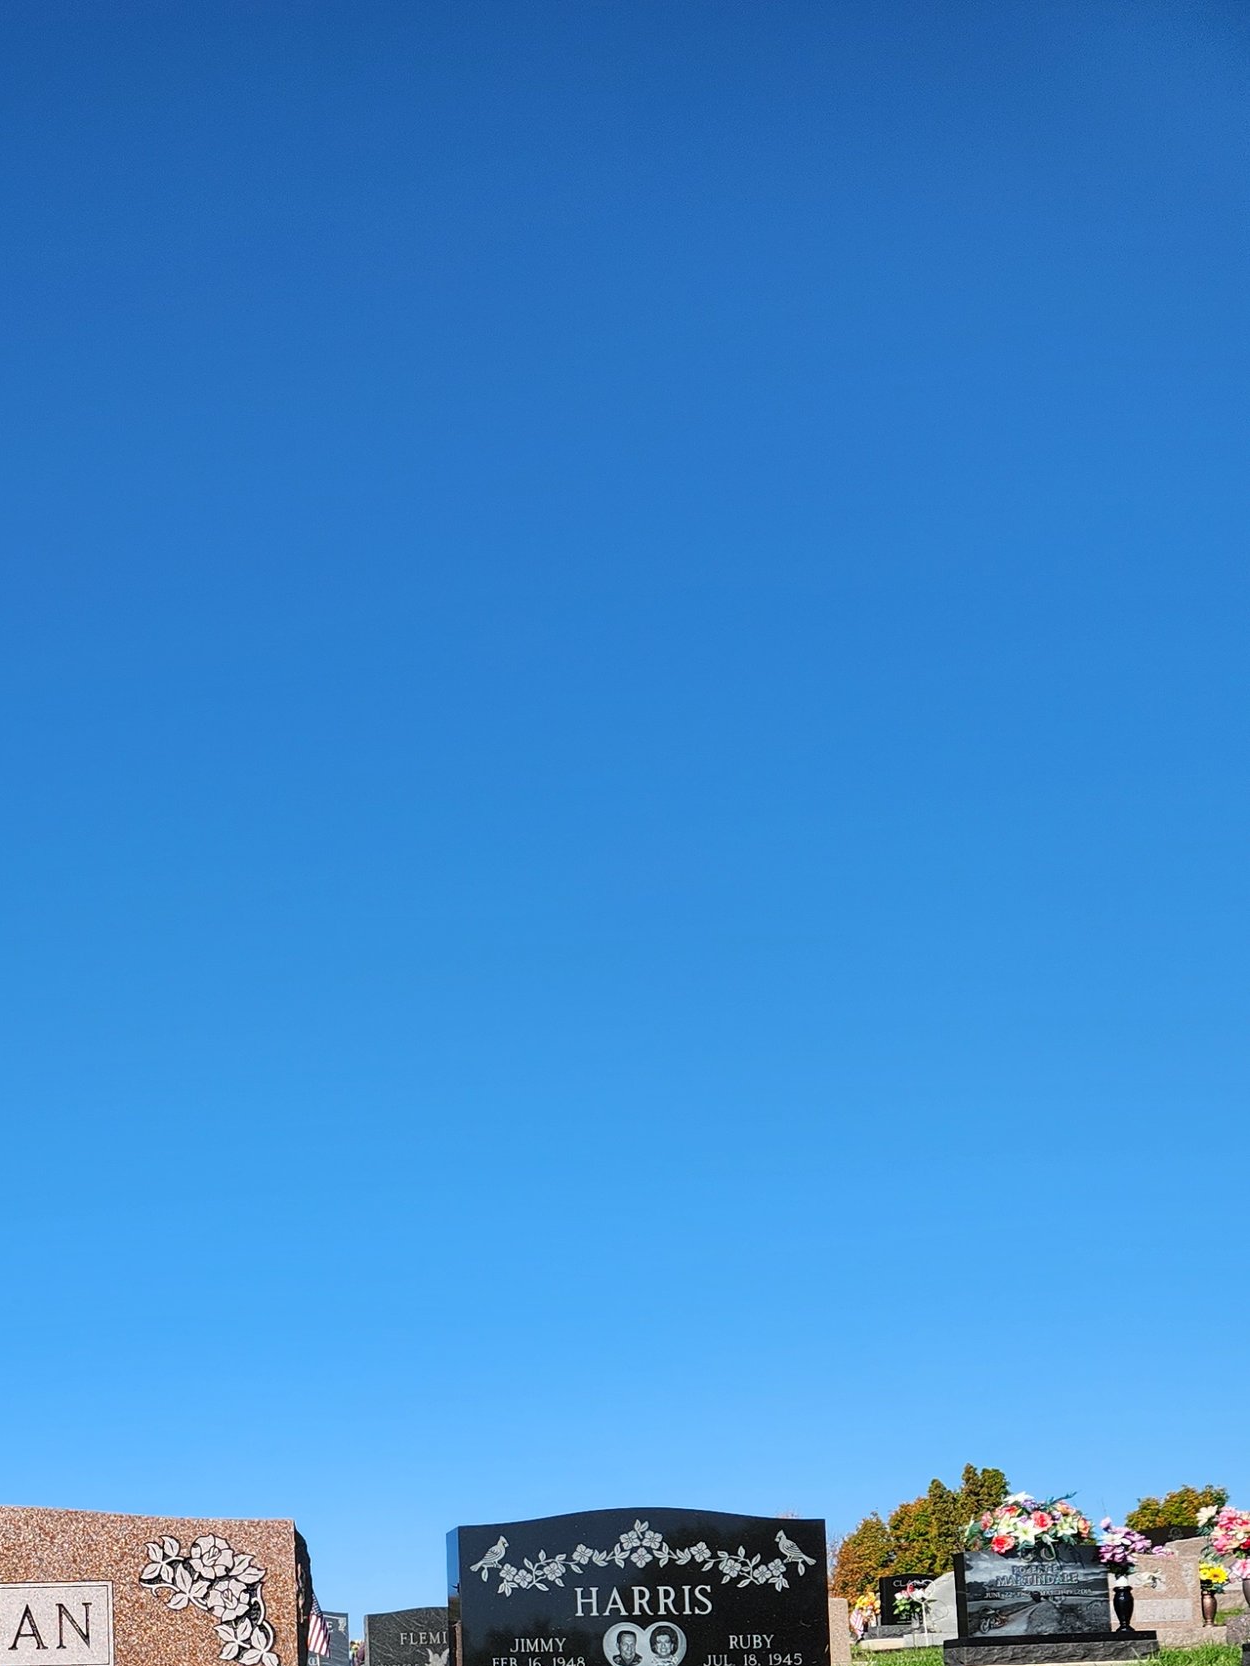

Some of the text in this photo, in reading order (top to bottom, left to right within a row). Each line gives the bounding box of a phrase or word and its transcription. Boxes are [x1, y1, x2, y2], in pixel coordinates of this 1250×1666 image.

[996, 1573, 1079, 1587] MARTINDALE
[574, 1585, 713, 1617] HARRIS
[400, 1631, 448, 1645] FLEMI
[728, 1634, 774, 1650] RUBY
[509, 1638, 567, 1653] JIMMY
[703, 1654, 736, 1666] JUL.
[768, 1652, 803, 1666] 1945
